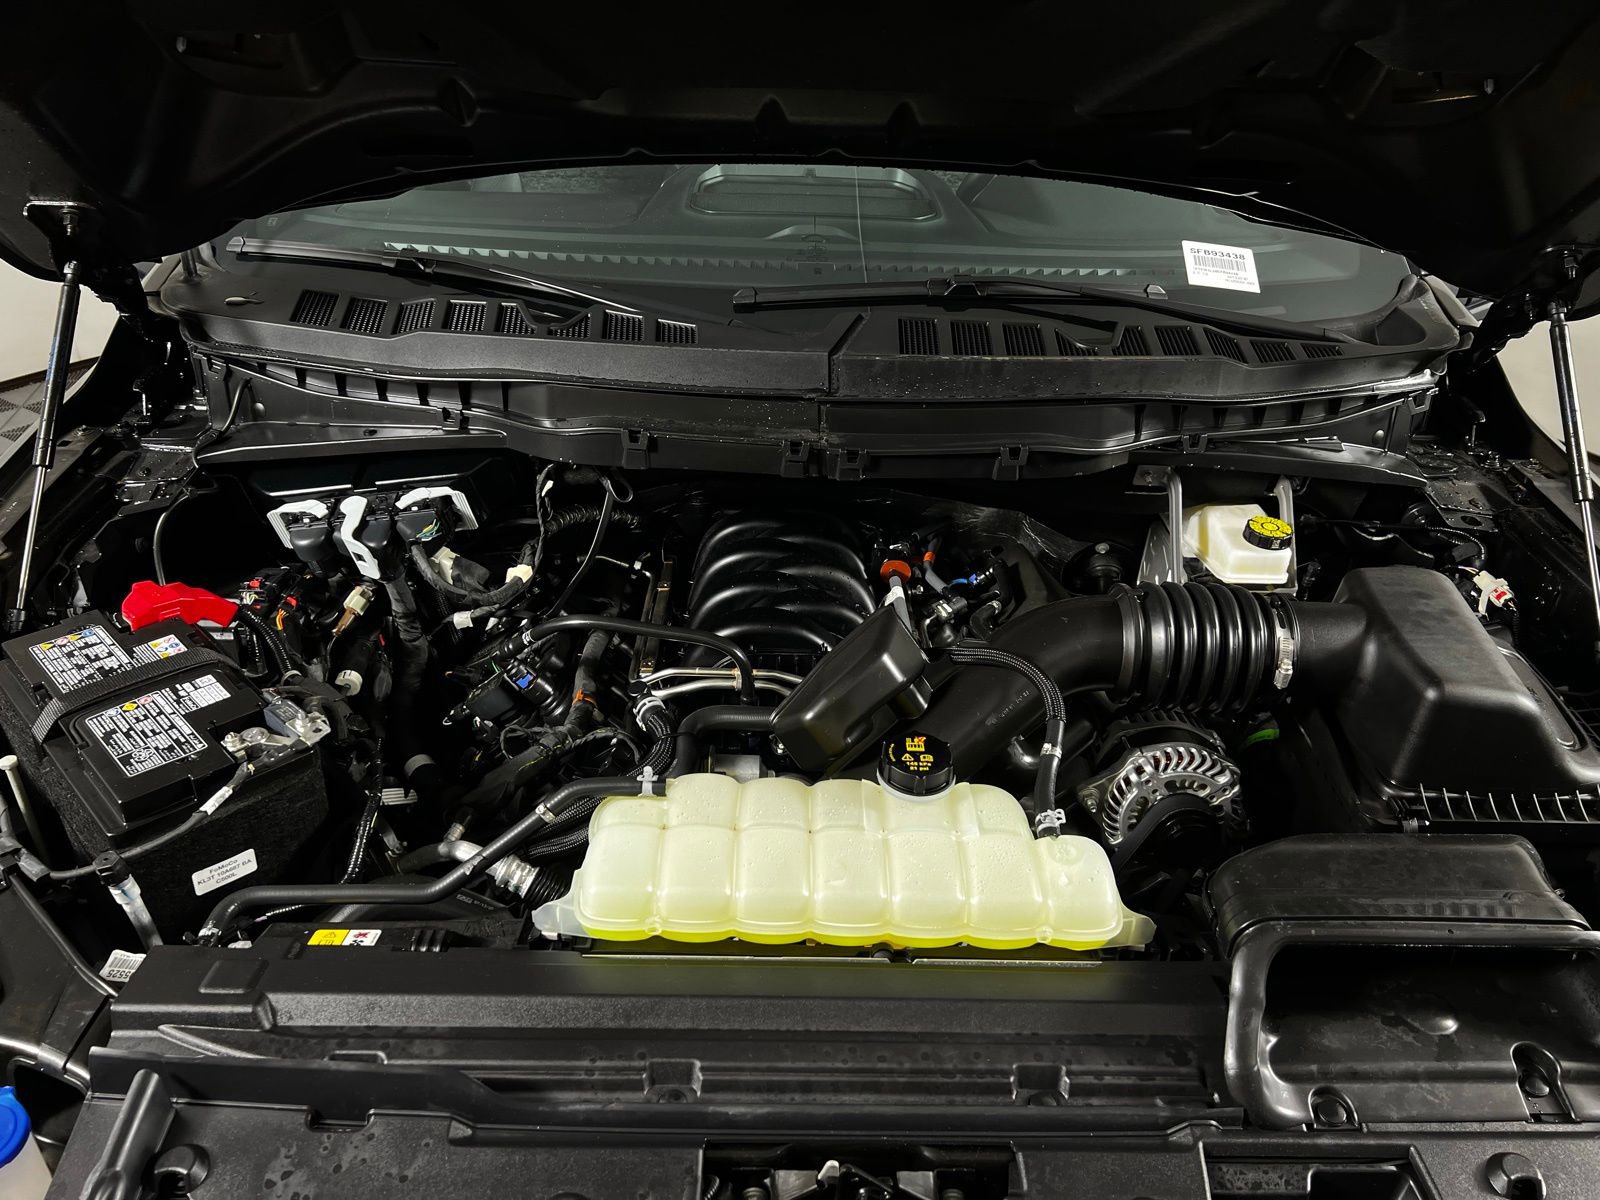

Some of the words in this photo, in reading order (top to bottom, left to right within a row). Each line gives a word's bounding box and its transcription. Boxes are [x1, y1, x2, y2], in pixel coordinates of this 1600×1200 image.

[1190, 247, 1246, 260] SFB93438
[209, 859, 238, 874] FoMoCo
[197, 874, 215, 885] KL3T
[106, 969, 132, 979] 5525
